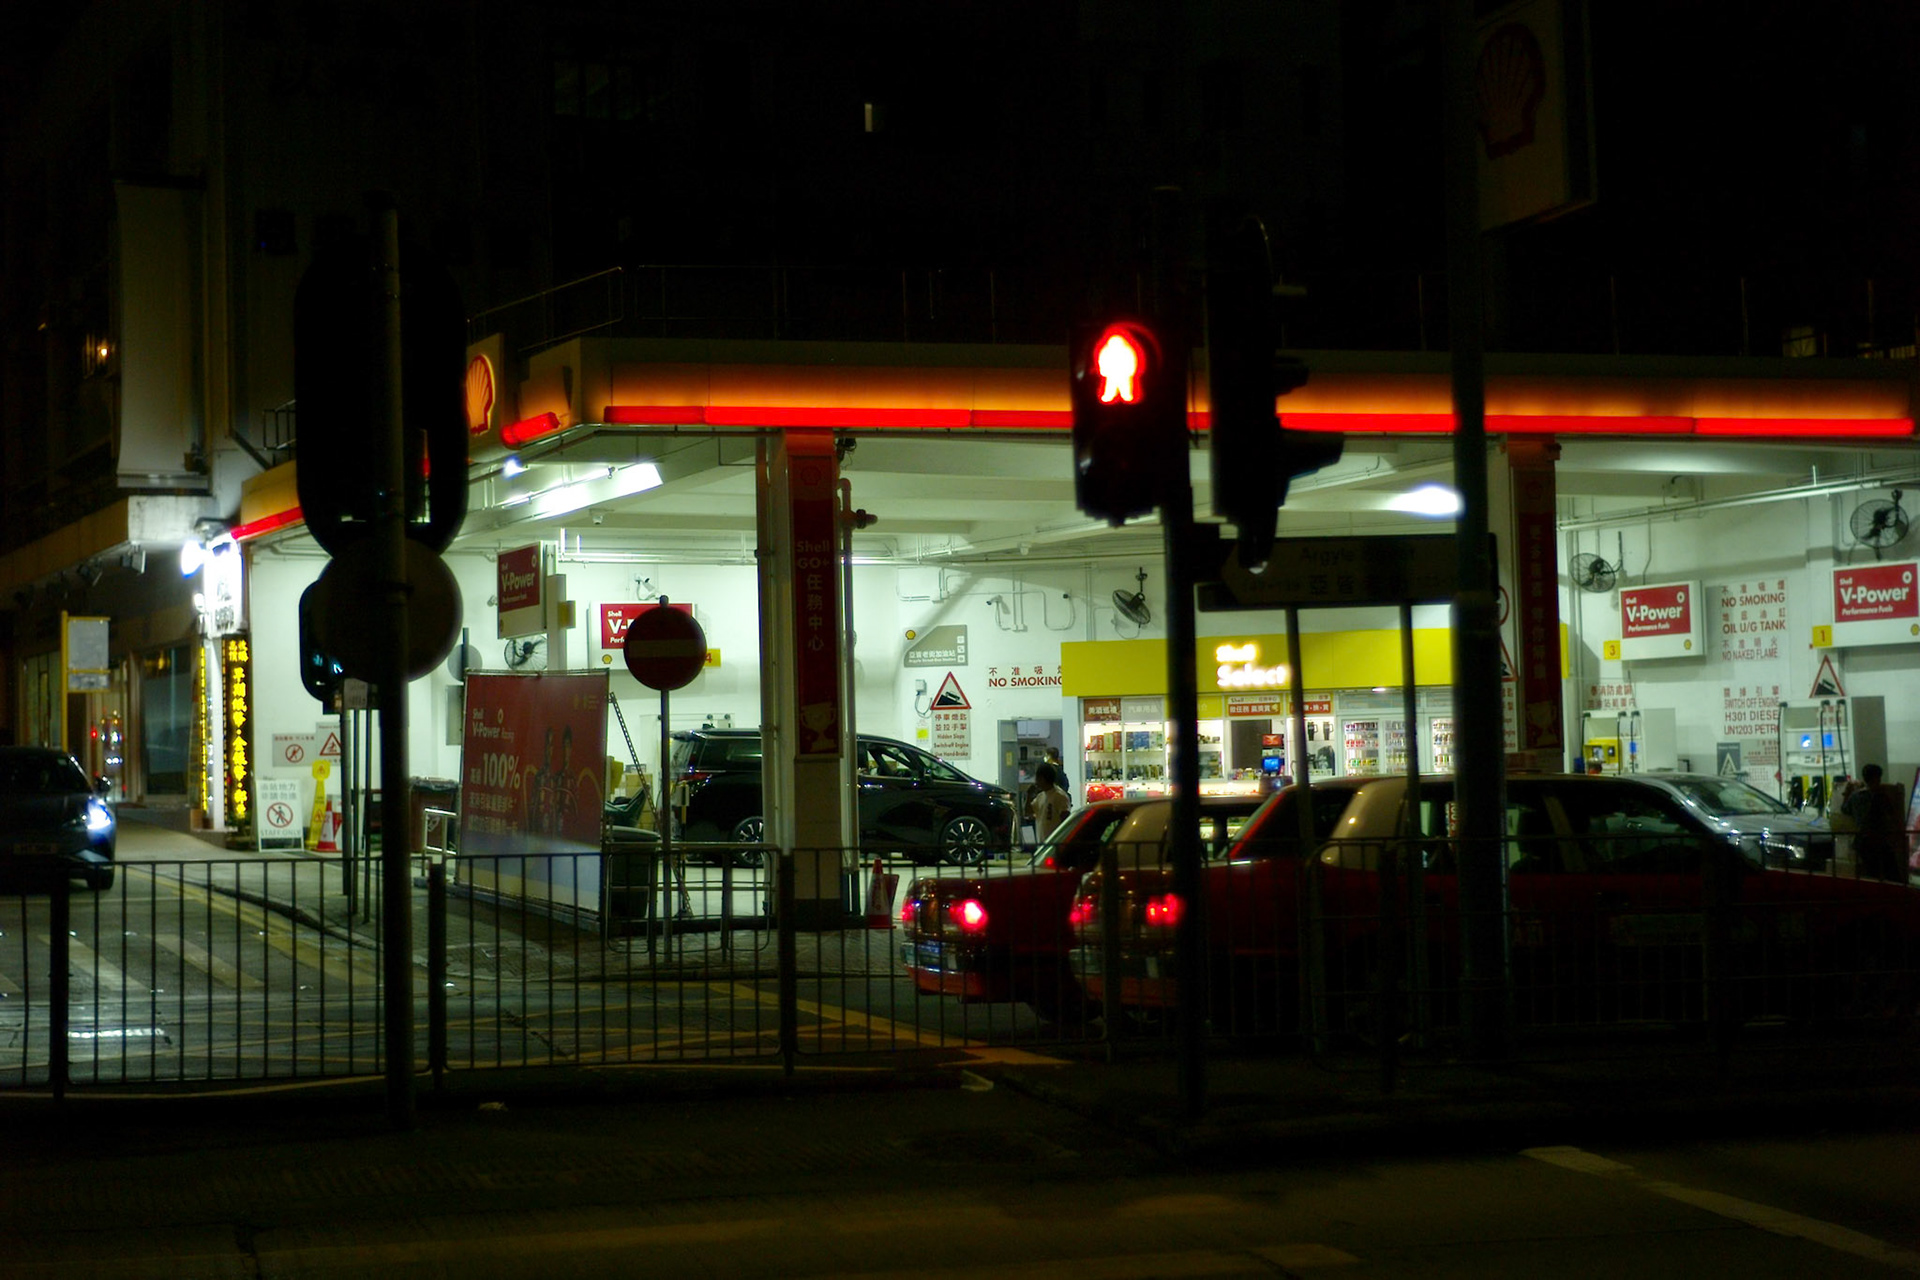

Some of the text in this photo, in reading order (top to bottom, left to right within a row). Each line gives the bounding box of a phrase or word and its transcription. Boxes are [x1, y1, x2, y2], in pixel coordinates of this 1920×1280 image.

[796, 539, 830, 553] Shell
[796, 556, 830, 570] GO+
[1300, 547, 1355, 567] Argyle
[501, 570, 536, 593] V-Power
[1839, 576, 1853, 586] Shell
[1625, 597, 1637, 605] Shell
[1721, 591, 1786, 608] NO SMOKING
[1839, 583, 1911, 606] V-Power
[607, 610, 623, 618] Shell
[805, 573, 825, 653] 任務中心
[1626, 603, 1683, 623] V-Power
[1841, 605, 1878, 616] Performance
[1627, 624, 1657, 634] Performance
[1722, 619, 1786, 635] OIL U/G TANK
[1608, 644, 1616, 656] 3
[1722, 647, 1778, 661] NO NAKED FLAME
[1216, 664, 1287, 686] Select
[989, 678, 1007, 688] NO
[1723, 696, 1780, 709] SWITCH OFF ENGINE
[1724, 710, 1779, 722] H301 DIESE
[472, 721, 501, 739] V-Power
[1723, 723, 1779, 736] UN1203 PETR
[483, 752, 521, 791] 100%
[259, 828, 301, 837] STAFF ONLY
